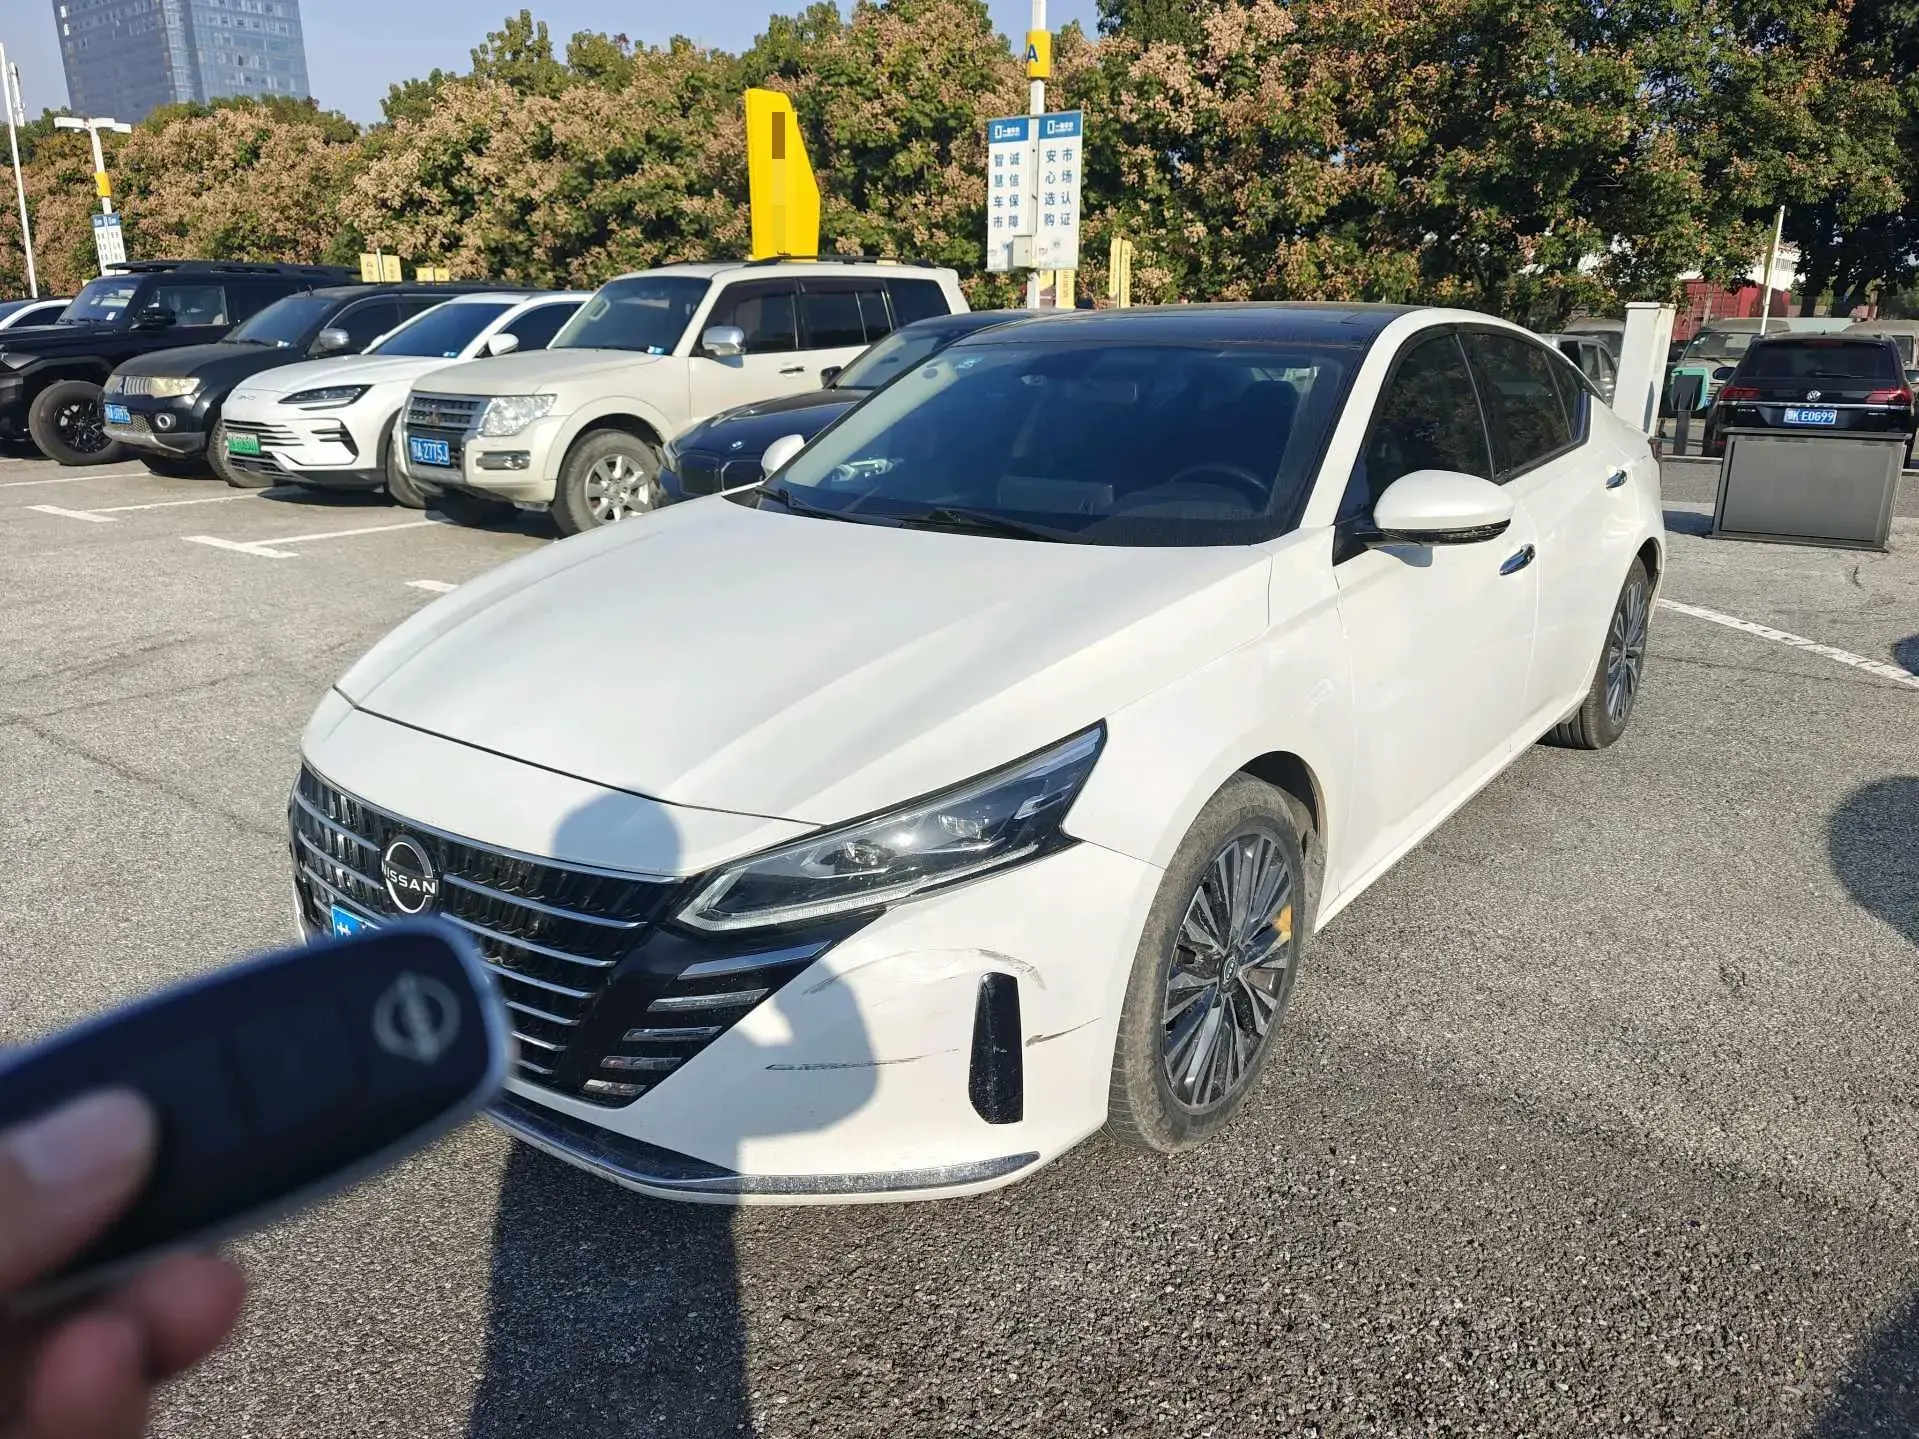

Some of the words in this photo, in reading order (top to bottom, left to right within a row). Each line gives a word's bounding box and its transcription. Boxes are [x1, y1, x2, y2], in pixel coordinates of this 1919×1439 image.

[1026, 44, 1038, 63] A
[993, 153, 1004, 228] 智慧车市
[1008, 152, 1020, 229] 诚信保障
[1044, 149, 1057, 226] 安心选购
[1060, 147, 1073, 226] 市场认证
[381, 859, 436, 894] NISSAN
